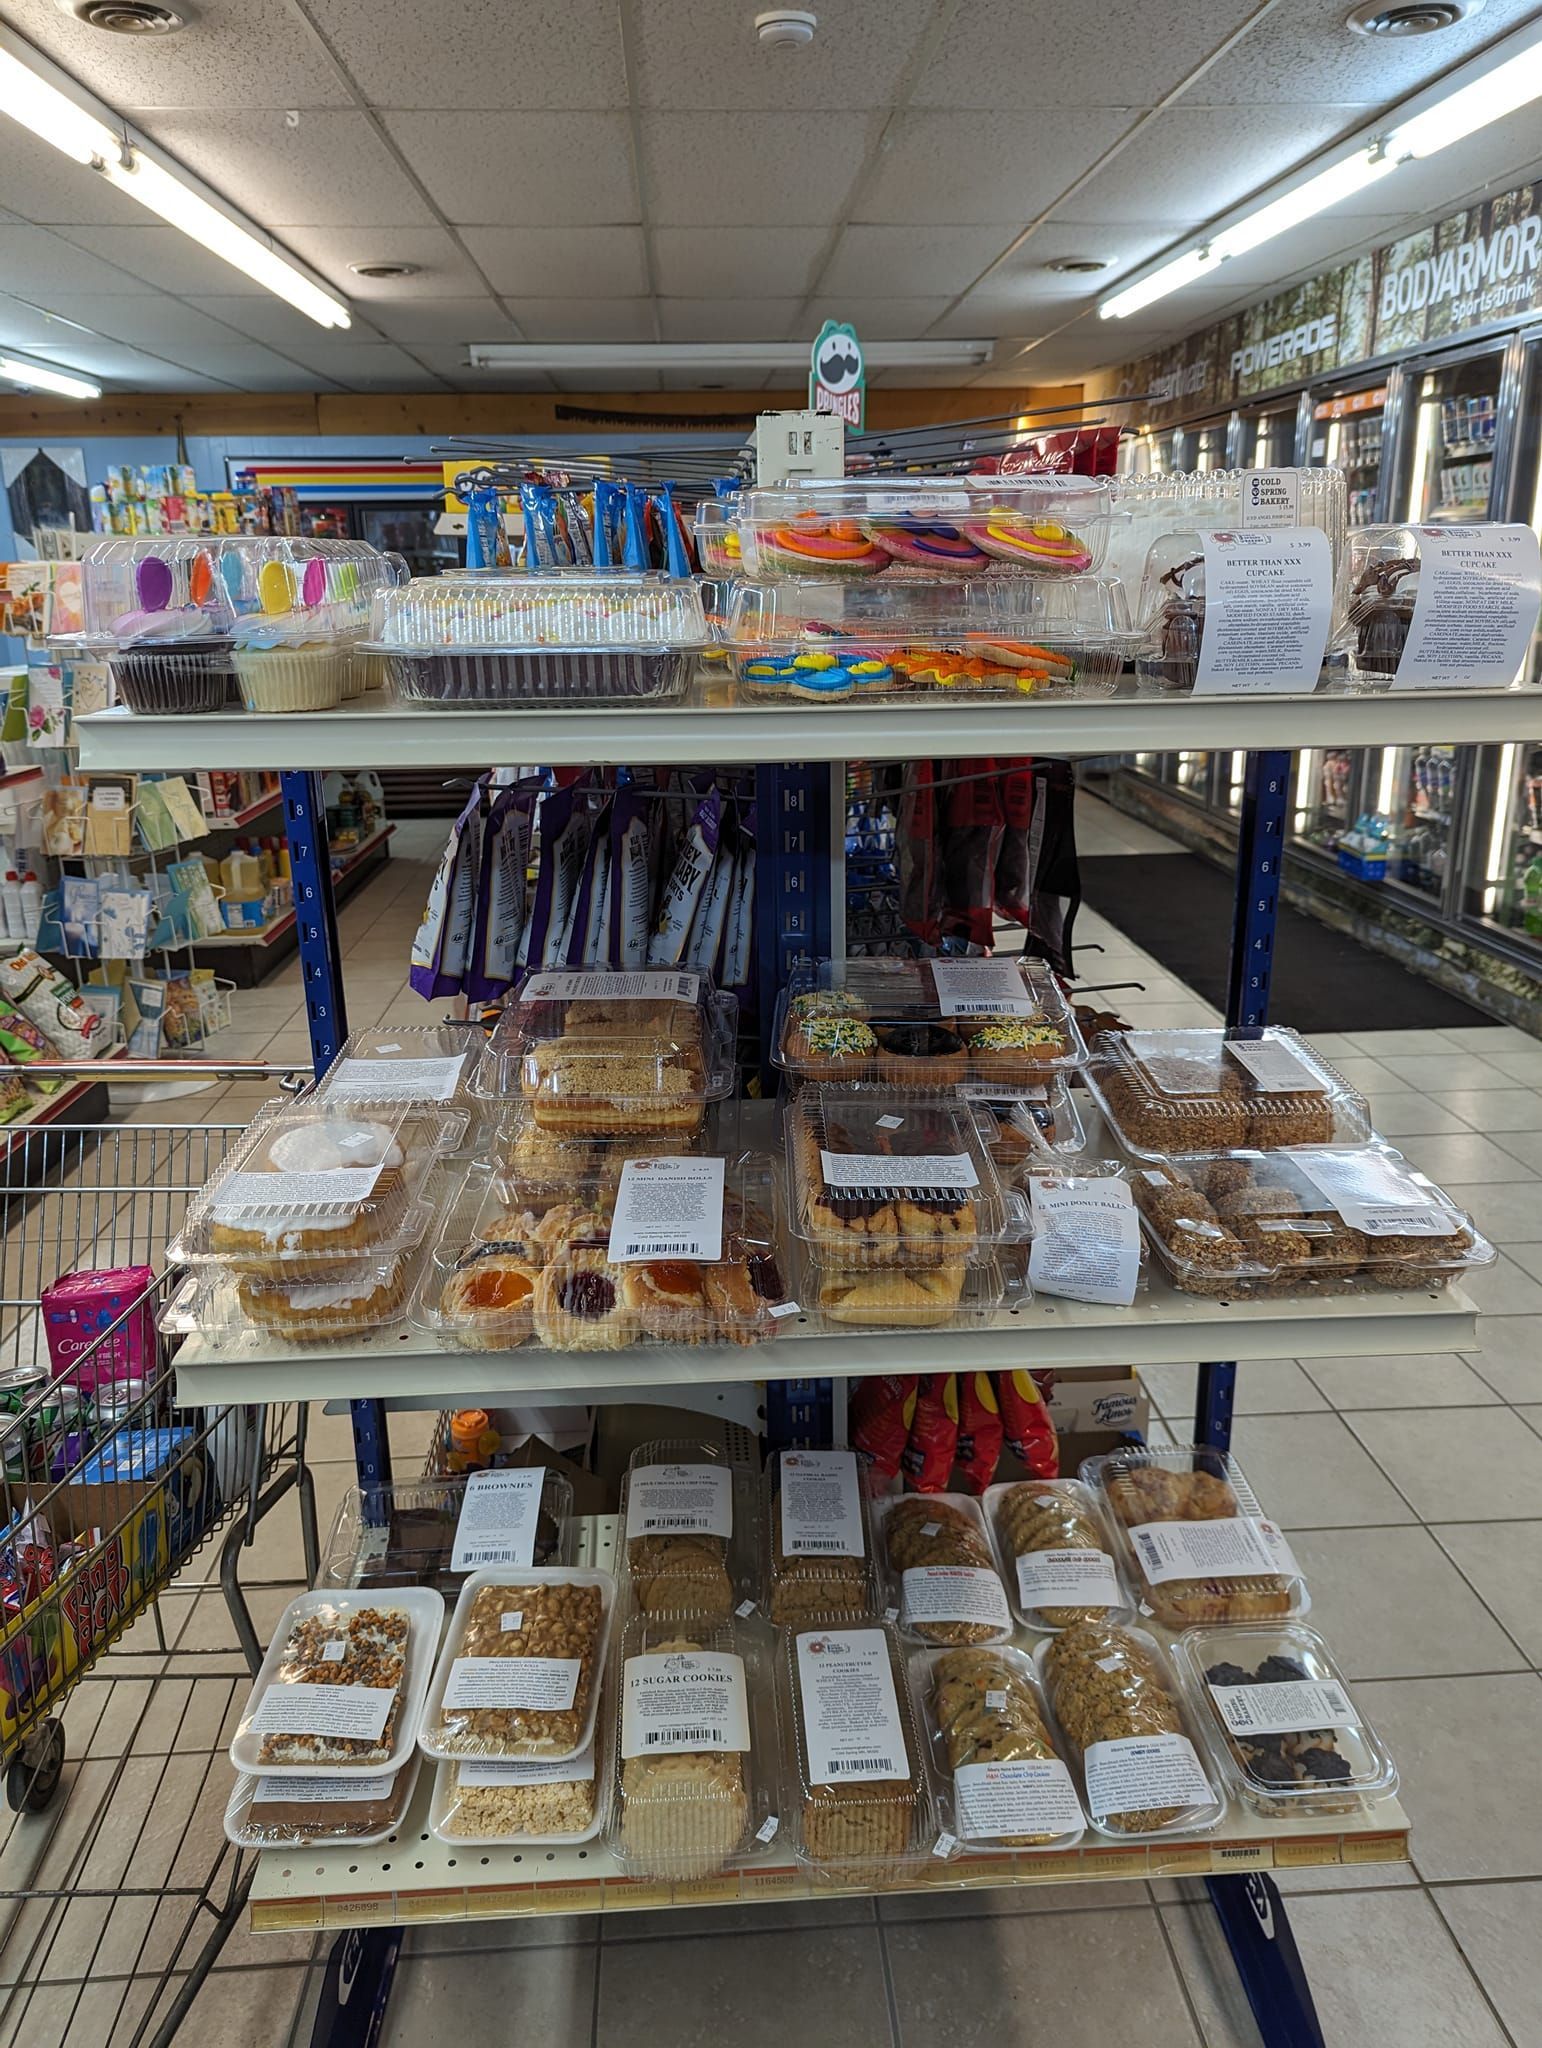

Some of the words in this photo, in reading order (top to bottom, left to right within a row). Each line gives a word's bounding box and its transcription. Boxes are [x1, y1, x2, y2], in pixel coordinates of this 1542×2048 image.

[1381, 215, 1542, 321] BODYARMOR
[1451, 292, 1494, 324] Sports
[1494, 276, 1535, 308] Drink
[1230, 313, 1337, 380] POWERADE
[816, 386, 860, 425] PRINGLES
[1260, 478, 1281, 486] COLD
[1260, 487, 1287, 496] SPRING
[1260, 497, 1290, 505] BAKERY
[1441, 550, 1471, 558] BETTER
[1496, 551, 1512, 559] XXX
[1227, 559, 1258, 567] BETTER
[1261, 558, 1282, 566] THAN
[1460, 560, 1497, 569] CUPCAKE
[1246, 569, 1285, 577] CUPCAKE
[1270, 782, 1276, 792] 8
[791, 796, 797, 806] 8
[297, 805, 303, 815] 8
[1266, 822, 1272, 832] 7
[791, 837, 797, 847] 7
[301, 847, 307, 857] 7
[1262, 862, 1268, 872] 6
[792, 877, 797, 887] 6
[306, 887, 312, 897] 6
[1259, 901, 1264, 911] 5
[791, 916, 798, 926] 5
[311, 928, 317, 938] 5
[1255, 939, 1261, 949] 4
[315, 968, 321, 977] 4
[1251, 977, 1257, 987] 3
[320, 1007, 326, 1016] 3
[1248, 1015, 1254, 1024] 2
[324, 1045, 330, 1055] 2
[1049, 1201, 1069, 1209] MINI
[361, 1399, 367, 1408] 2
[1091, 1397, 1136, 1416] Famous
[1095, 1408, 1132, 1425] Amos
[367, 1464, 373, 1474] 0
[477, 1482, 533, 1491] BROWNIES
[62, 1535, 121, 1632] Ring
[630, 1680, 640, 1688] 12
[642, 1676, 680, 1685] SUGAR
[683, 1674, 733, 1683] COOKIES
